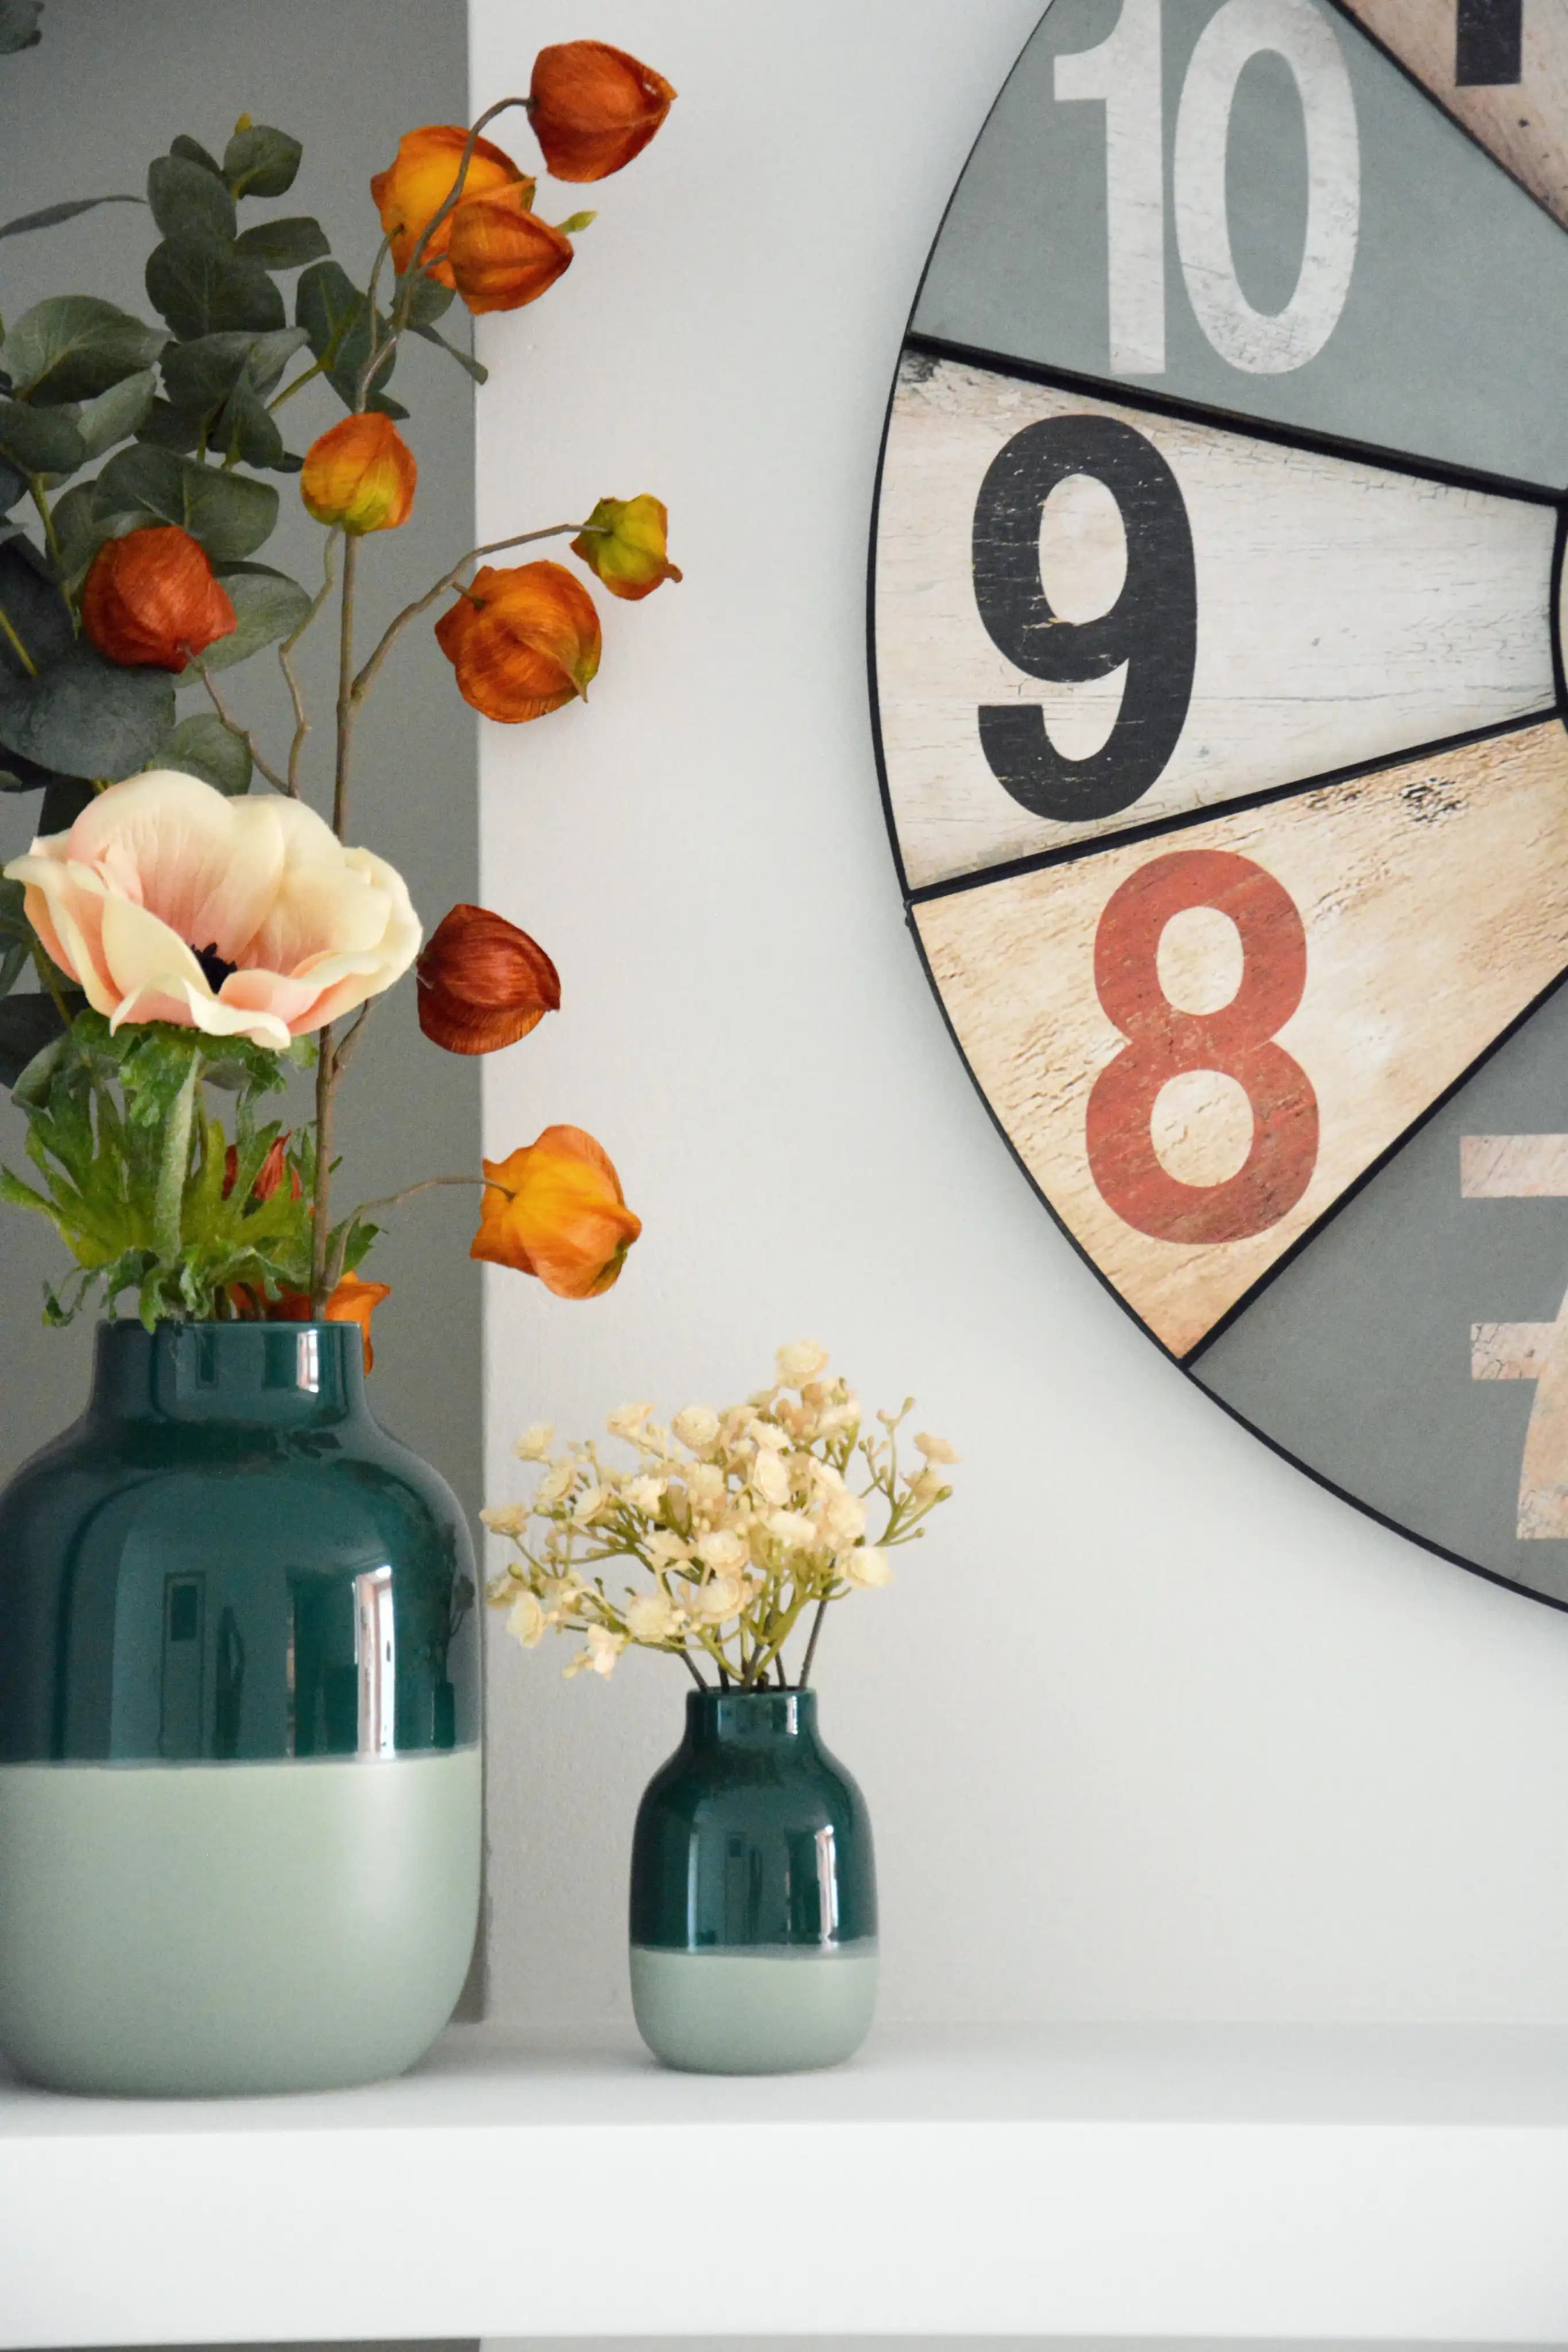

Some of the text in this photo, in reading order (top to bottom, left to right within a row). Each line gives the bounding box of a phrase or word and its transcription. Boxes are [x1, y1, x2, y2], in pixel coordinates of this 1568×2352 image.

[1053, 0, 1360, 375] 10
[971, 414, 1197, 822] 9
[1085, 849, 1319, 1245] 8
